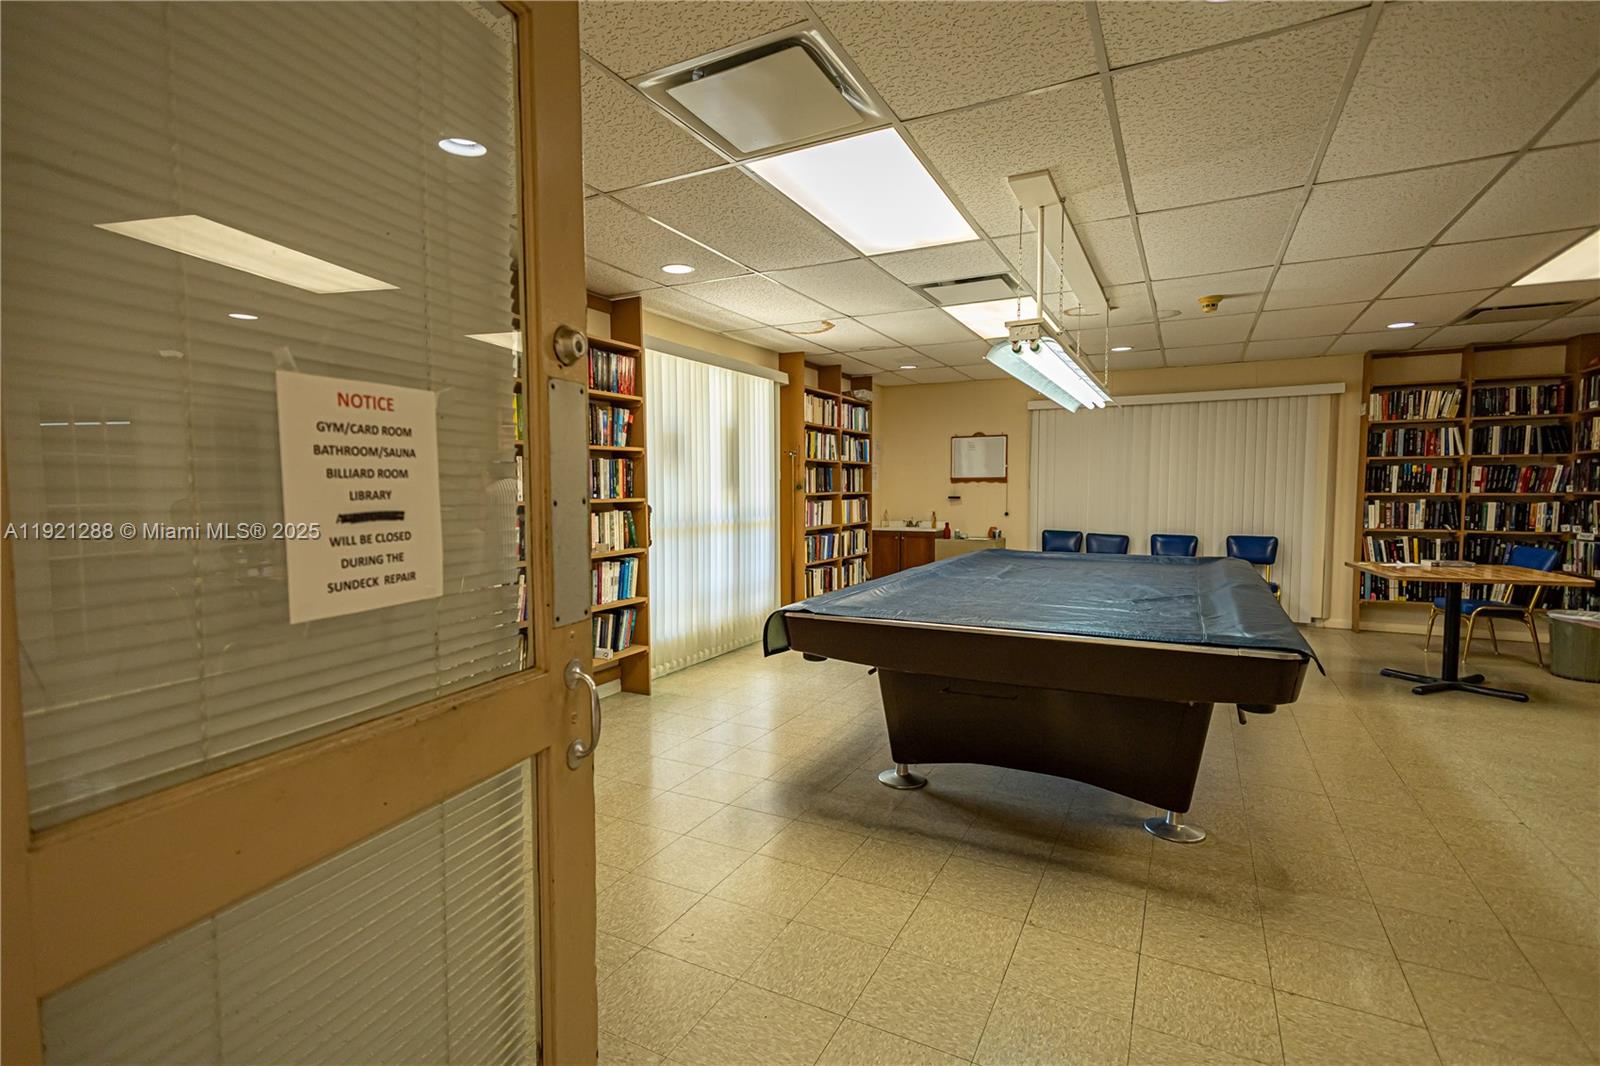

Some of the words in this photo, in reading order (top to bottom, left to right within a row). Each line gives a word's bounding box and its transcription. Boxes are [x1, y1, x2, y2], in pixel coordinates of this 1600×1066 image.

[337, 392, 394, 412] NOTICE
[316, 421, 379, 435] GYM/CARD
[381, 426, 412, 437] ROOM
[313, 444, 416, 458] BATHROOM/SAUNA
[326, 468, 375, 479] BILLIARD
[377, 468, 409, 479] ROOM
[349, 490, 392, 501] LIBRARY
[329, 536, 356, 547] WILL
[360, 534, 373, 545] BE
[375, 531, 411, 543] CLOSED
[341, 555, 384, 569] DURING
[386, 552, 404, 563] THE
[327, 576, 379, 593] SUNDECK
[384, 571, 416, 585] REPAIR
